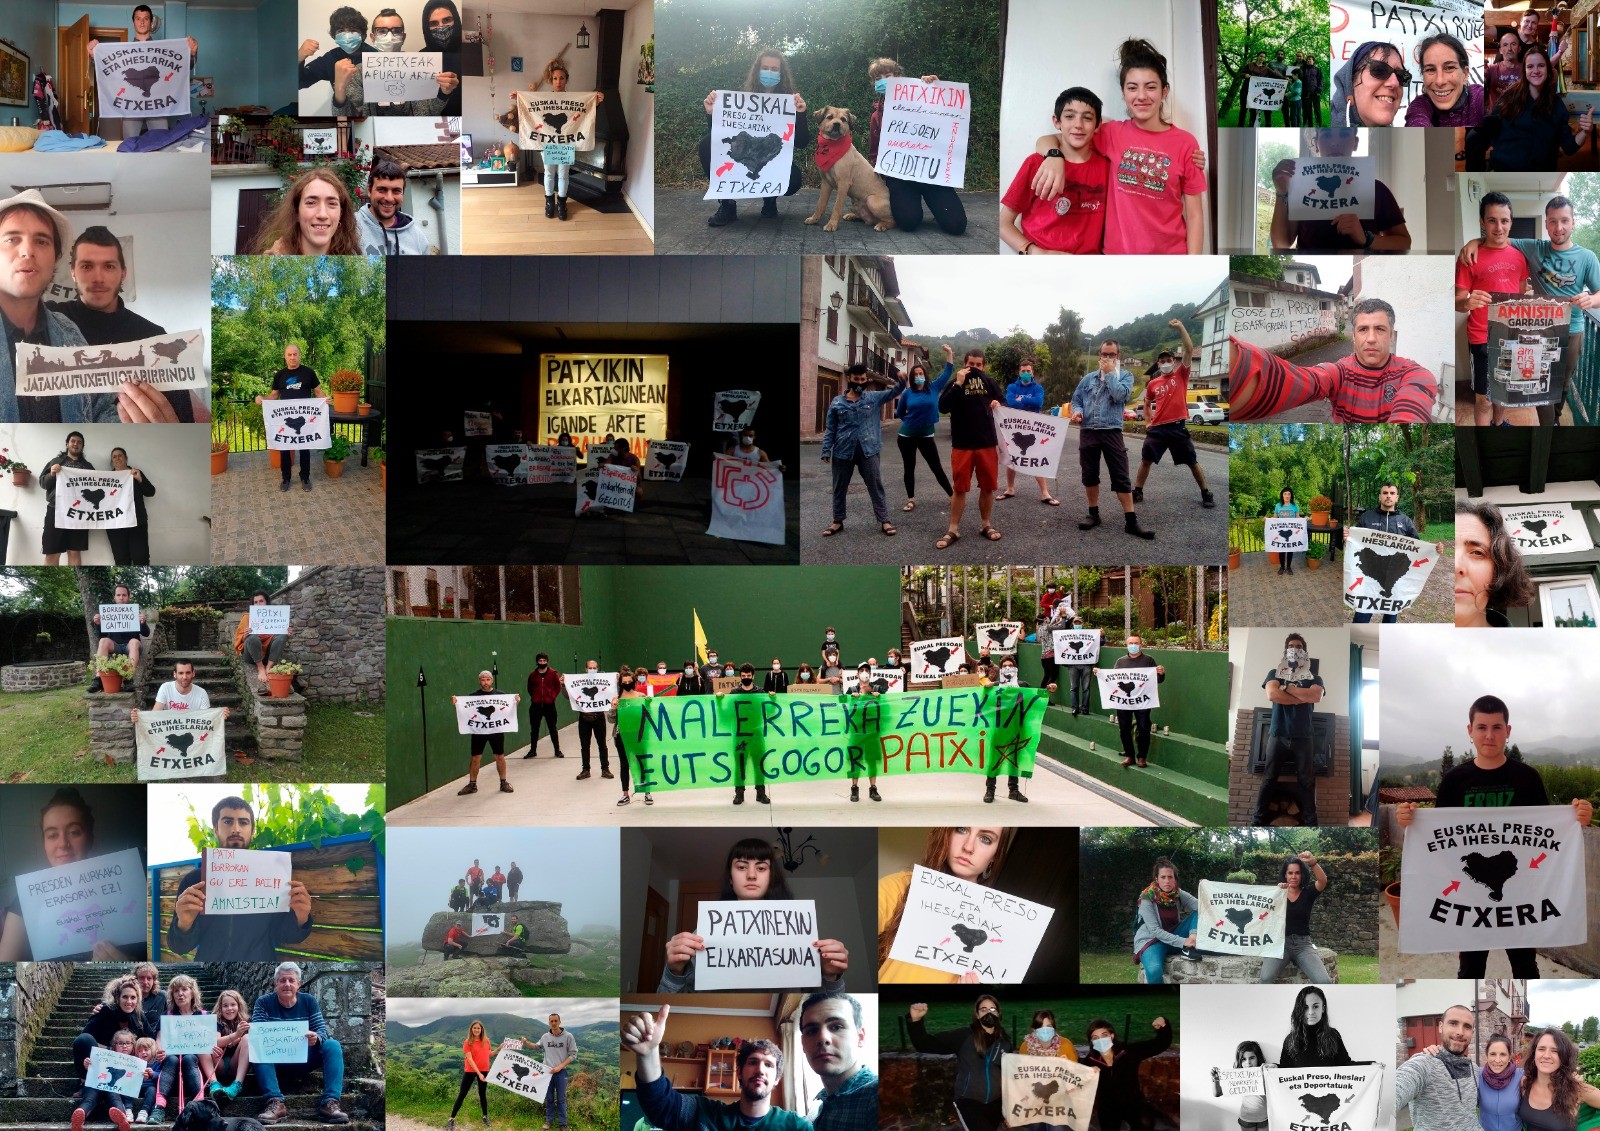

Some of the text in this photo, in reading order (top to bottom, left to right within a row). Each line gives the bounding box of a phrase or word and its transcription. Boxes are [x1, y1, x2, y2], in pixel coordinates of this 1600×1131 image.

[103, 48, 183, 66] EUSKAL PRESO
[367, 56, 434, 69] ESPETXEAK
[103, 55, 182, 77] ETA IHESLARIAK
[364, 69, 438, 81] APURTU ARTE
[113, 95, 178, 111] ETXERA
[892, 83, 965, 110] PATXIKIN
[1253, 98, 1284, 106] ETXERA
[543, 105, 586, 113] IHESLARIAK
[722, 92, 796, 117] EUSKAL
[722, 110, 764, 122] PRESO ETA
[530, 131, 585, 144] ETXERA
[886, 120, 940, 141] PRESOEN
[880, 149, 941, 179] GELDITU
[1317, 168, 1359, 177] IHESLARIAK
[715, 180, 783, 196] ETXERA
[1302, 196, 1359, 210] ETXERA
[1498, 305, 1564, 318] AMNISTIA
[1509, 319, 1554, 328] GARRASIA
[547, 359, 644, 383] PATXIKIN
[546, 384, 666, 406] ELKARTASUNEAN
[273, 406, 296, 414] EUSKAL
[547, 414, 646, 434] IGANDE ARTE
[715, 422, 748, 430] ETXERA
[1003, 419, 1055, 431] EUSKAL PRESO
[1014, 425, 1056, 437] IHESLARIAK
[275, 432, 322, 444] ETXERA
[649, 470, 681, 478] ETXERA
[81, 482, 123, 490] IHESLARIAK
[66, 507, 124, 521] ETXERA
[1271, 540, 1303, 548] ETXERA
[1361, 537, 1420, 553] IHESLARIAK
[1370, 532, 1415, 545] PRESO ETA
[1344, 592, 1412, 612] ETXERA
[914, 643, 934, 652] EUSKAL
[1060, 652, 1094, 660] ETXERA
[576, 699, 611, 709] ETXERA
[1110, 694, 1150, 705] ETXERA
[151, 719, 183, 729] EUSKAL
[468, 718, 510, 729] ETXERA
[638, 699, 881, 742] MALERREKA
[166, 724, 215, 732] IHESLARIAK
[150, 754, 216, 770] ETXERA
[760, 747, 867, 779] GOGOR
[1434, 823, 1555, 839] EUSKAL PRESO
[1427, 836, 1561, 853] ETA IHESLARIAK
[28, 864, 123, 896] PRESOEN AURKAKO
[209, 879, 223, 887] GU
[228, 879, 248, 888] ERE
[101, 881, 122, 896] EZ!
[920, 870, 1038, 921] EUSKAL PRESO
[211, 896, 280, 911] AMNISTIA!
[1226, 900, 1276, 911] IHESLARIAK
[1246, 894, 1274, 904] PRESO
[959, 900, 981, 914] ETA
[1429, 898, 1561, 928] ETXERA
[707, 909, 813, 936] PATXIREKIN
[920, 900, 1003, 938] IHESLARIAK
[1207, 928, 1274, 947] ETXERA
[705, 946, 816, 968] ELKARTASUNA
[1013, 1072, 1084, 1090] ETA IHESLARIAK
[1054, 1066, 1082, 1082] PRESO
[1279, 1073, 1366, 1084] Euskal Preso, Iheslari
[495, 1072, 538, 1094] ETXERA
[1289, 1082, 1353, 1090] eta Deportatuak
[1011, 1103, 1078, 1120] ETXERA
